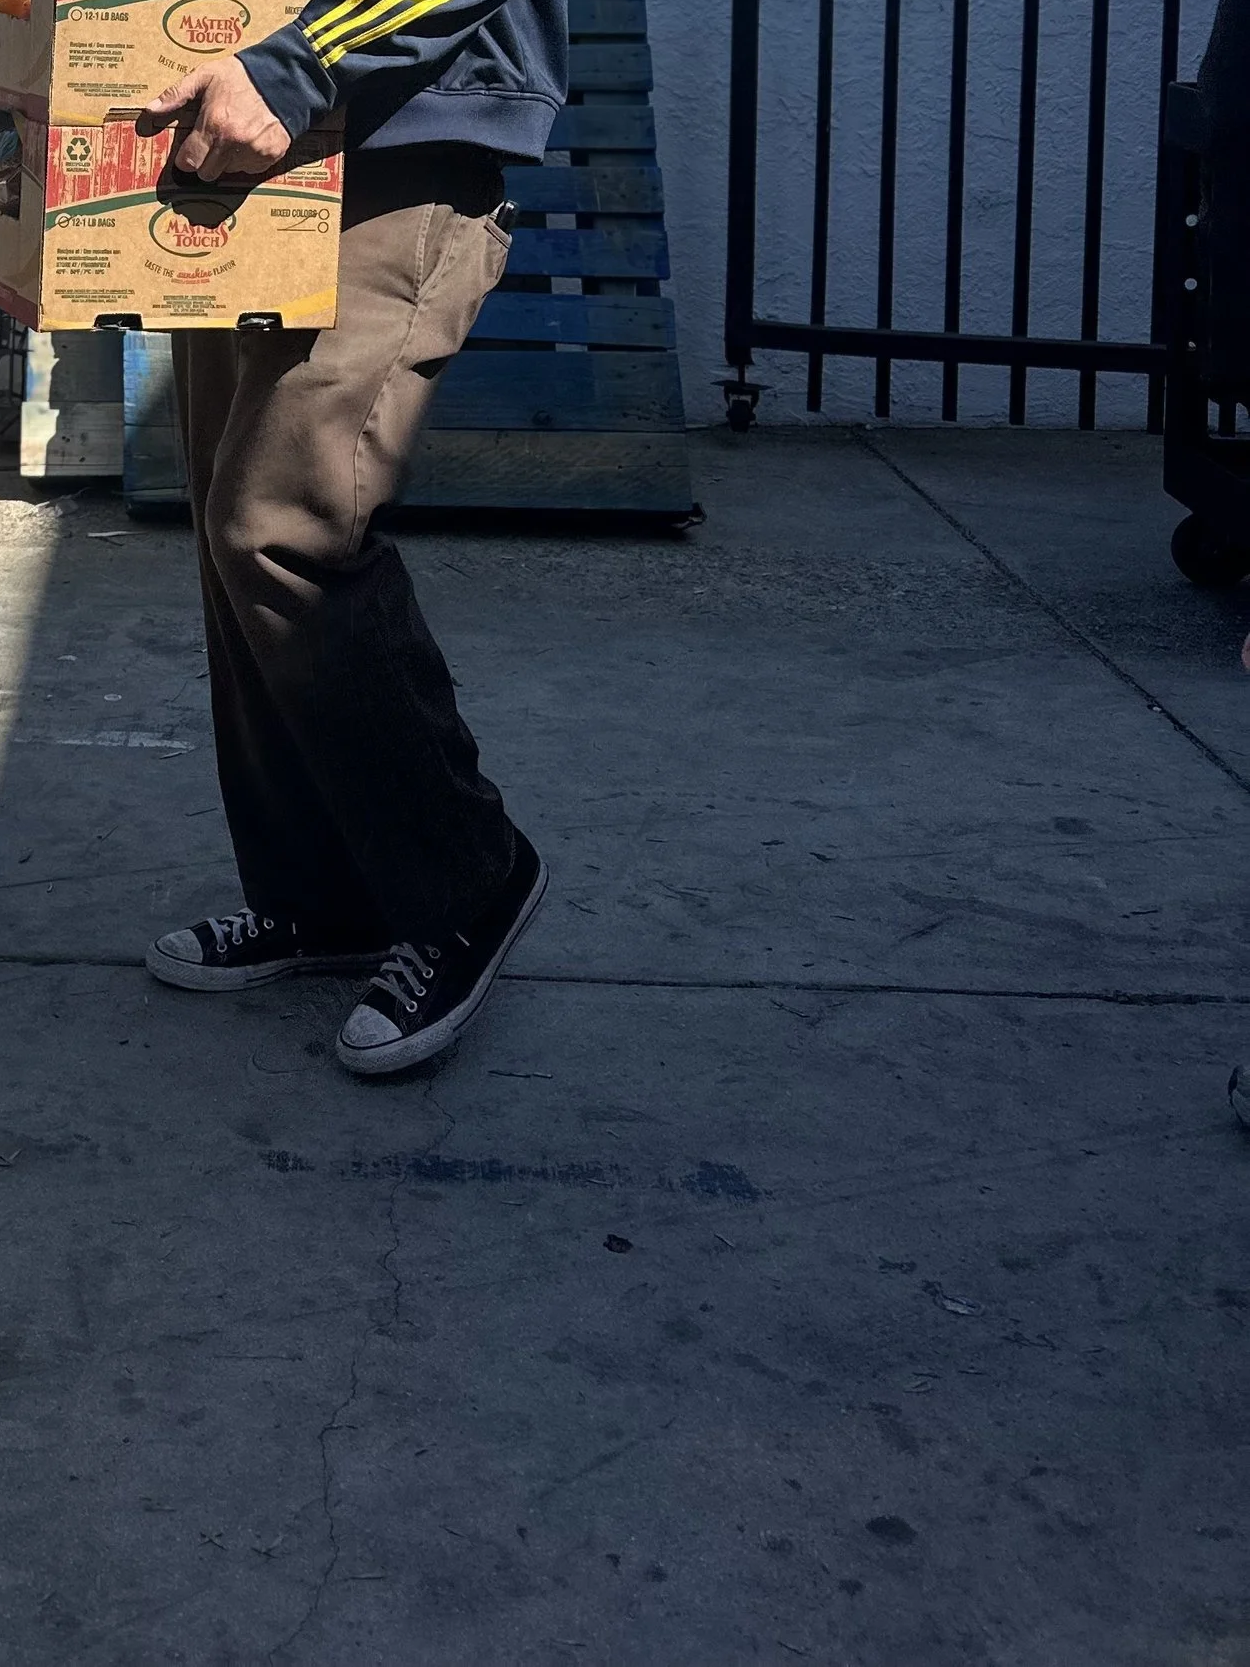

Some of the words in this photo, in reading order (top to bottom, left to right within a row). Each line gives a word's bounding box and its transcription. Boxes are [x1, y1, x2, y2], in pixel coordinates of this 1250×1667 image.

[84, 11, 99, 20] 12-1
[100, 11, 110, 21] LB
[111, 12, 129, 21] BAGS
[179, 14, 242, 44] MASTER'S
[186, 29, 234, 44] TOUCH
[157, 54, 175, 70] TASTE
[176, 63, 188, 73] THE
[270, 208, 291, 217] MIXED
[292, 209, 318, 218] COLORS
[72, 218, 86, 227] 12-1
[87, 218, 97, 227] LB
[97, 218, 116, 228] BAGS
[173, 234, 220, 248] TOUCH
[144, 259, 163, 274] TASTE
[162, 268, 174, 278] THE
[212, 259, 236, 276] FLAVOR
